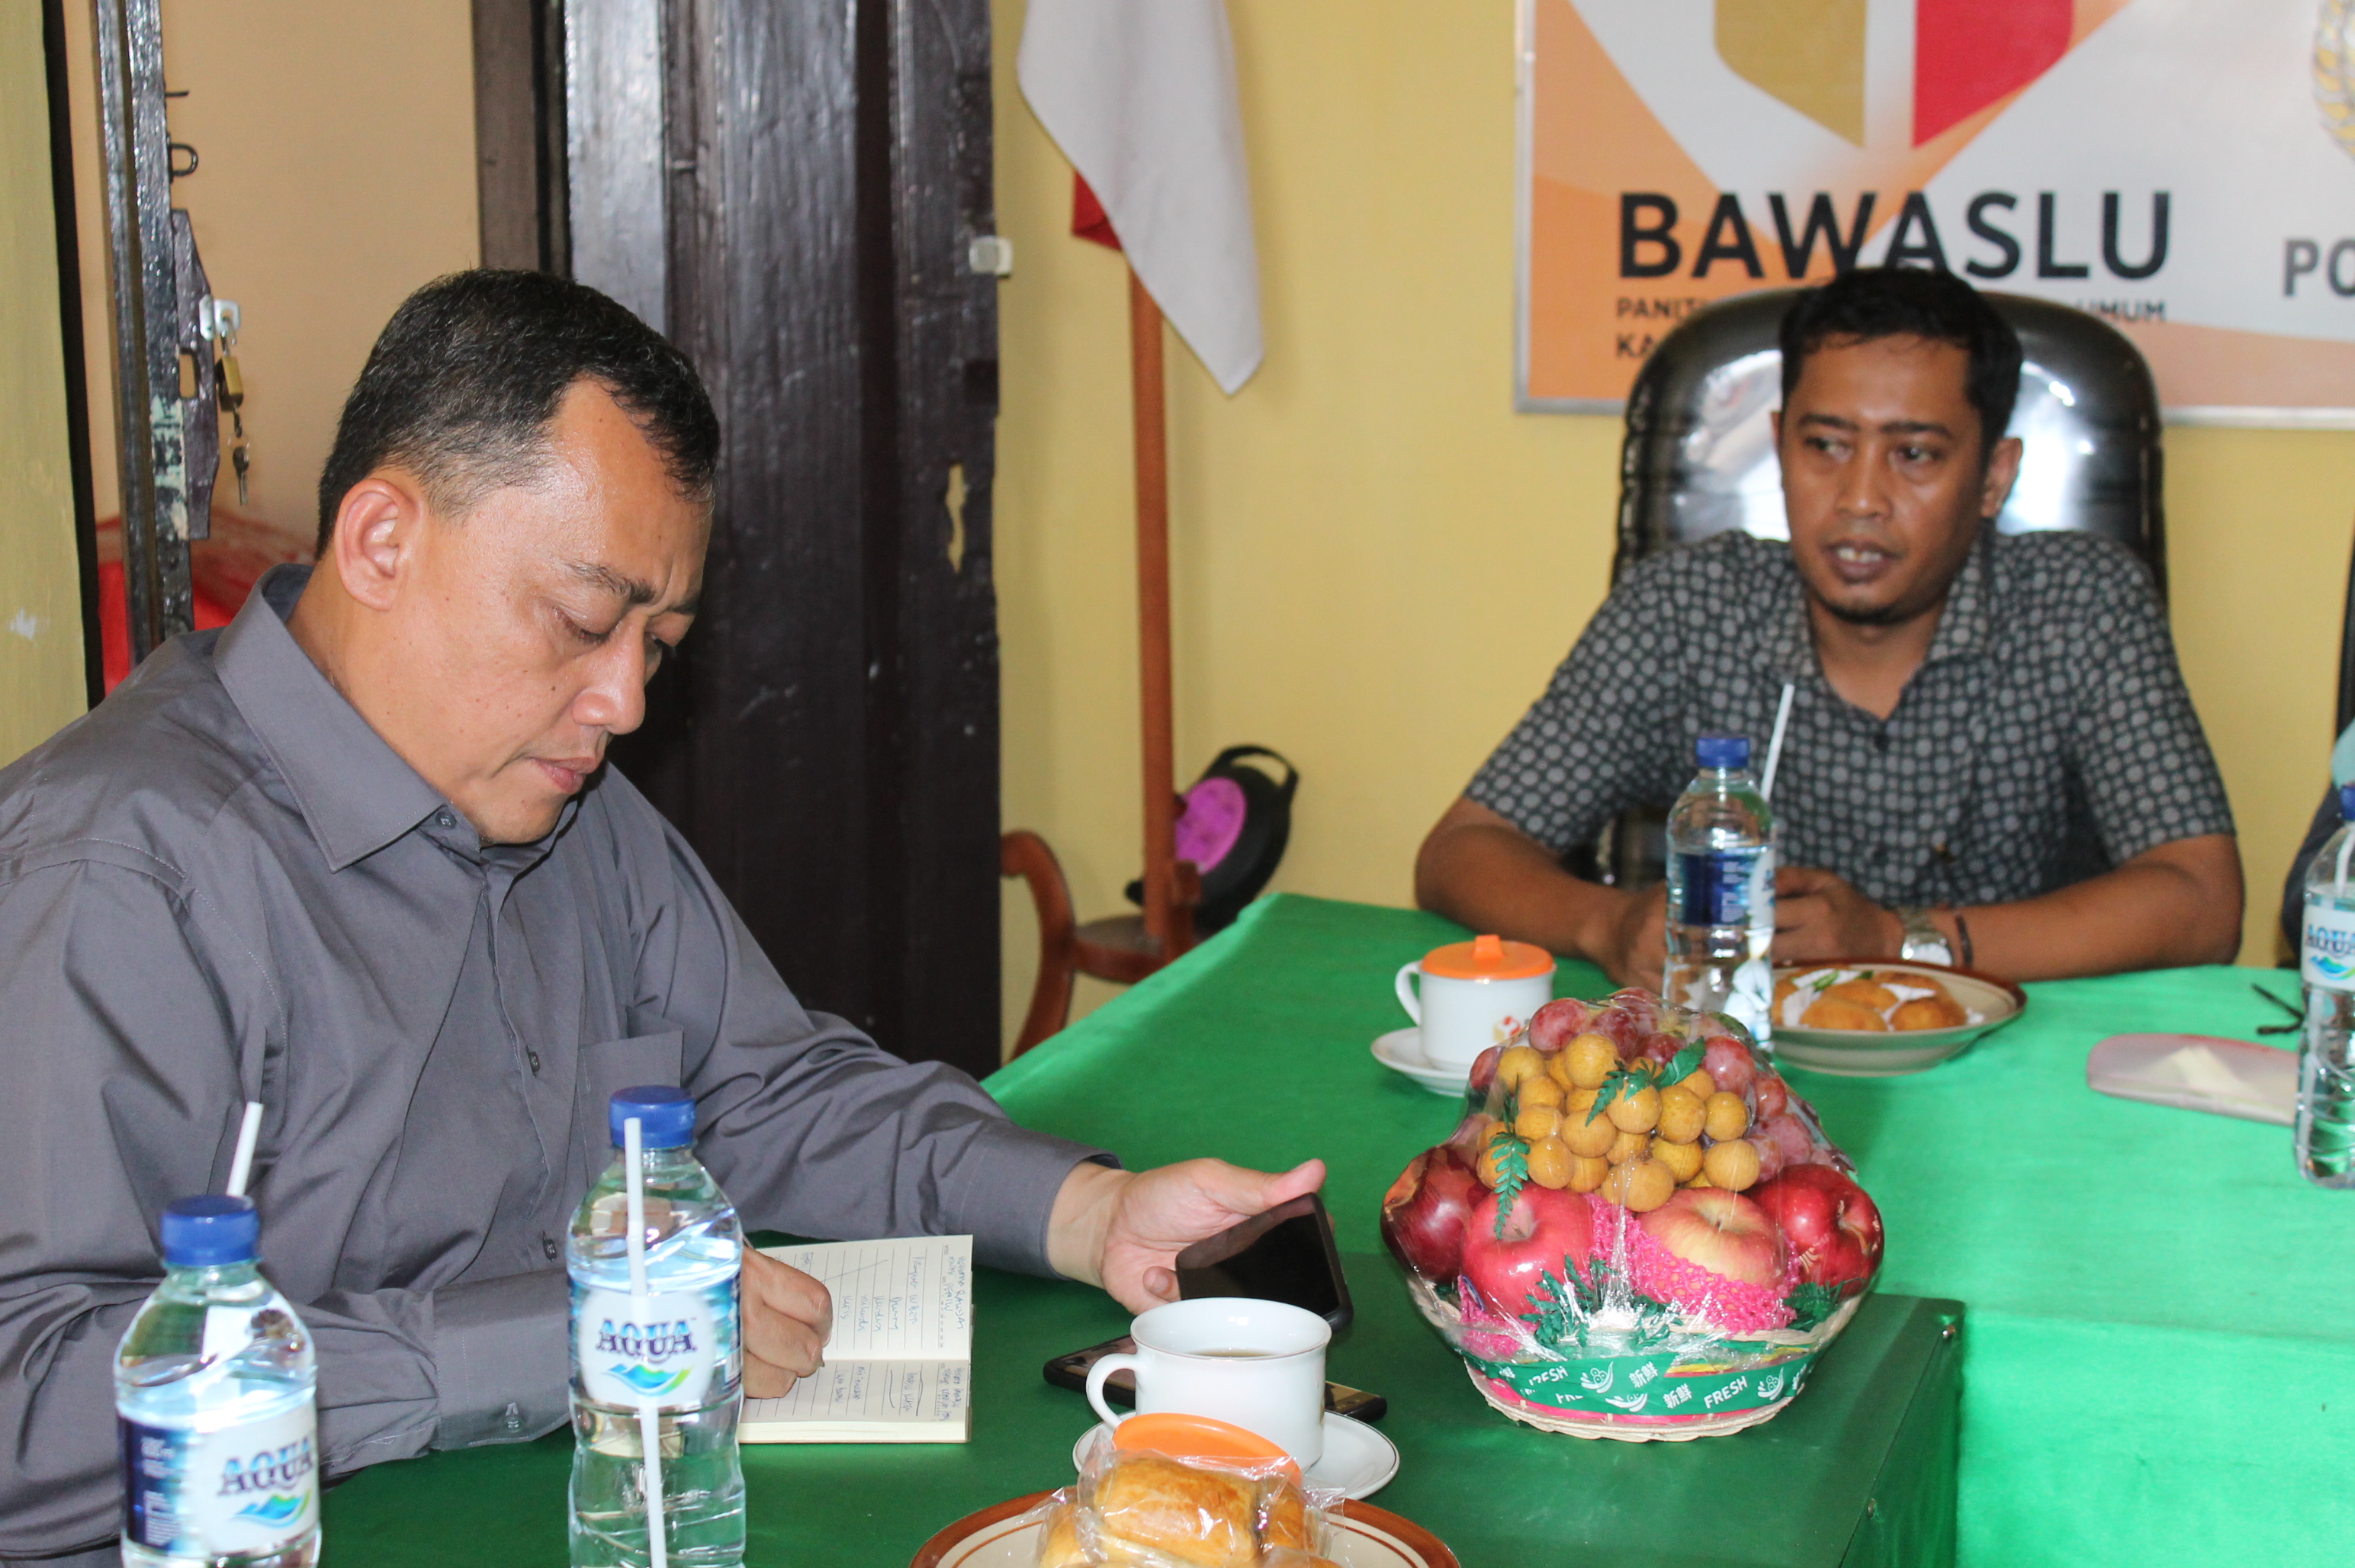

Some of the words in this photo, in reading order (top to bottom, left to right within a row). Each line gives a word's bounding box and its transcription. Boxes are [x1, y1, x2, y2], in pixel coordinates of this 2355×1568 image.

[1618, 190, 2170, 281] BAWASLU
[596, 1318, 698, 1357] AQUA
[1703, 1375, 1749, 1409] FRESH
[217, 1436, 313, 1496] AQUA
